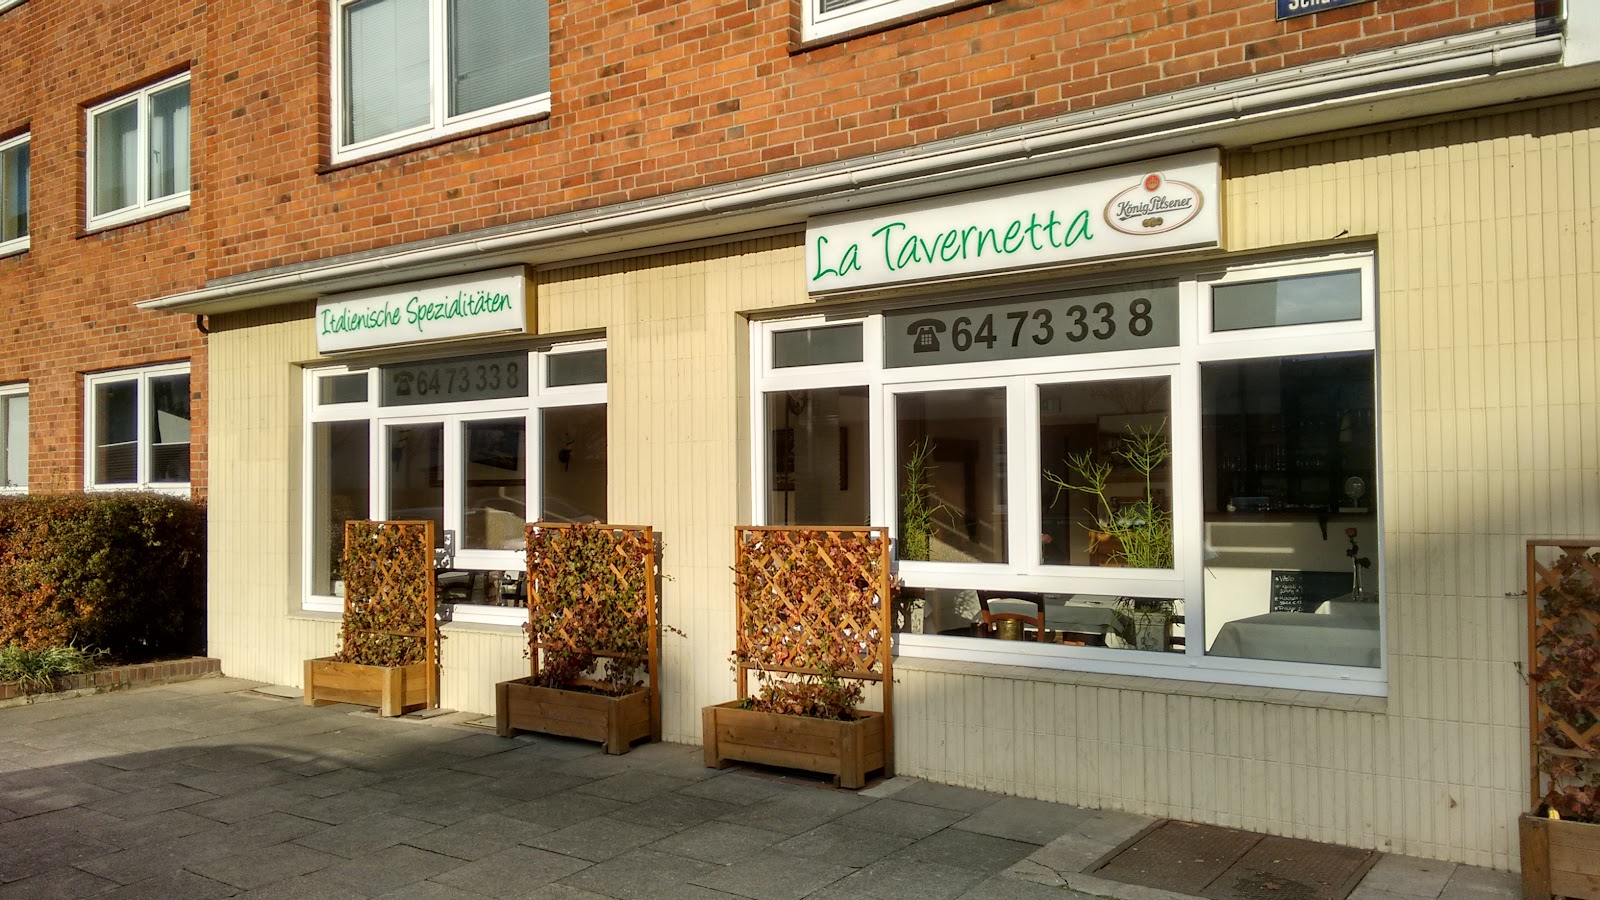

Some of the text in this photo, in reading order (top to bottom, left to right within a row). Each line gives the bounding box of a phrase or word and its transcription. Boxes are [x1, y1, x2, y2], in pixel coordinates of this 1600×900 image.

[1116, 195, 1193, 217] König Pilsener
[812, 208, 1095, 282] La Tavernetta
[321, 290, 512, 336] Italienische Spezialitäten
